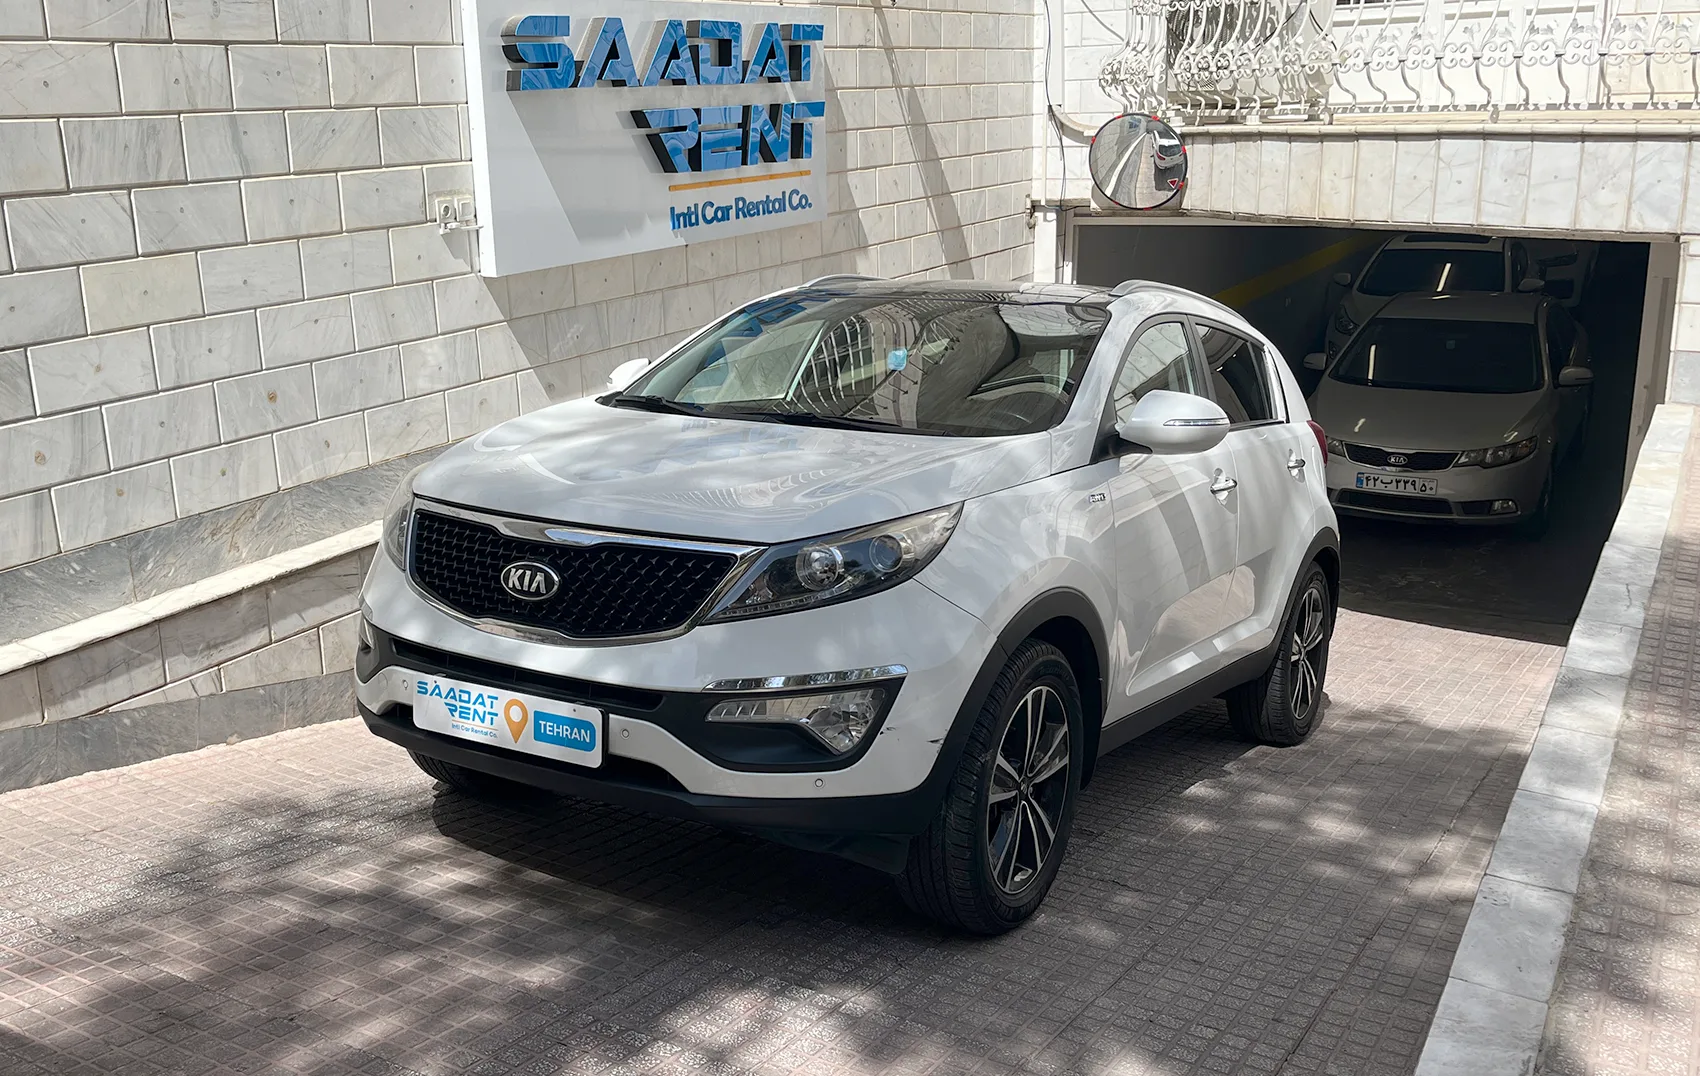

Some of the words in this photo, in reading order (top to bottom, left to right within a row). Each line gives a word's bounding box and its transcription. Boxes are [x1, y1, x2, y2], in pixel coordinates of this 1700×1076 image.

[501, 15, 824, 91] SAADAT
[630, 101, 825, 173] RENT
[670, 203, 700, 231] Intl
[701, 200, 733, 225] Car
[735, 190, 787, 220] Rental
[788, 188, 813, 211] Co.
[508, 568, 547, 594] KIA
[416, 680, 499, 709] SAADAT
[443, 702, 499, 726] RENT
[471, 727, 488, 736] Rental
[488, 731, 498, 739] Co.
[539, 721, 590, 743] TEHRAN
